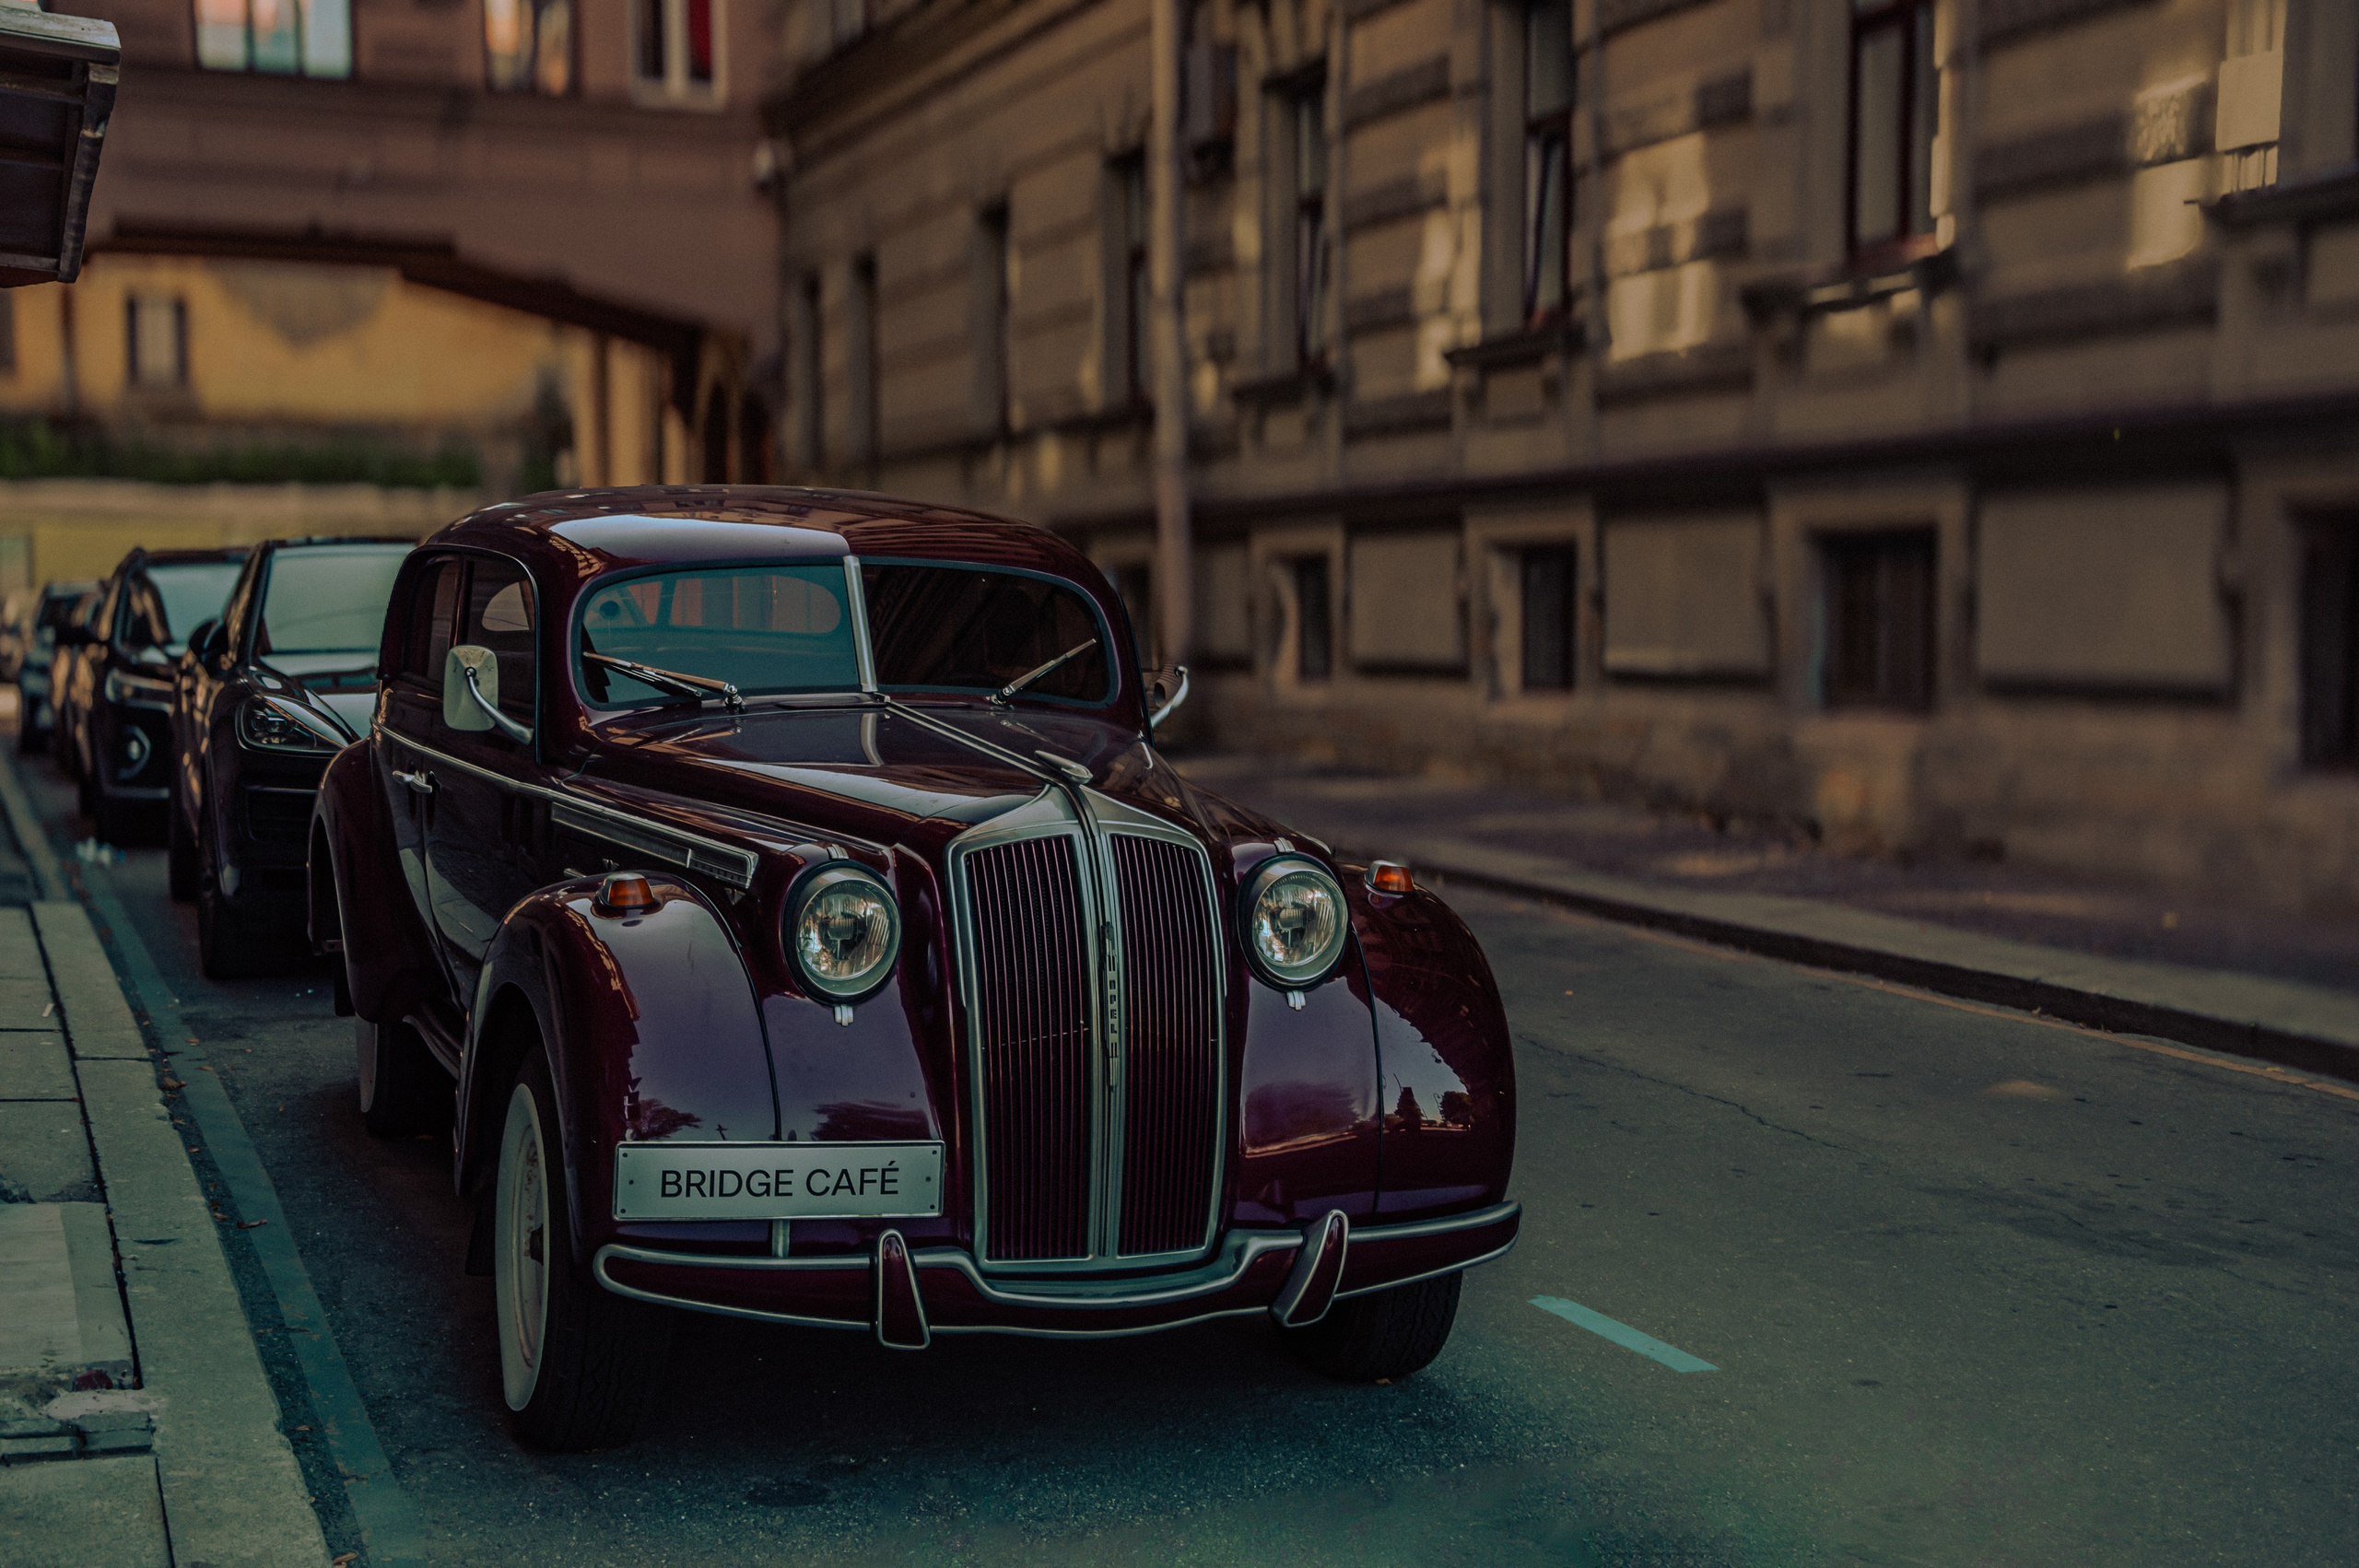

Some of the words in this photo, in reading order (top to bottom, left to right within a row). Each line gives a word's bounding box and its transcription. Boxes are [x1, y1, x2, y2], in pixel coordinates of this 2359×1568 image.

[1109, 979, 1118, 1034] OPEL
[661, 1169, 794, 1198] BRIDGE
[805, 1160, 899, 1197] CAFÉ
